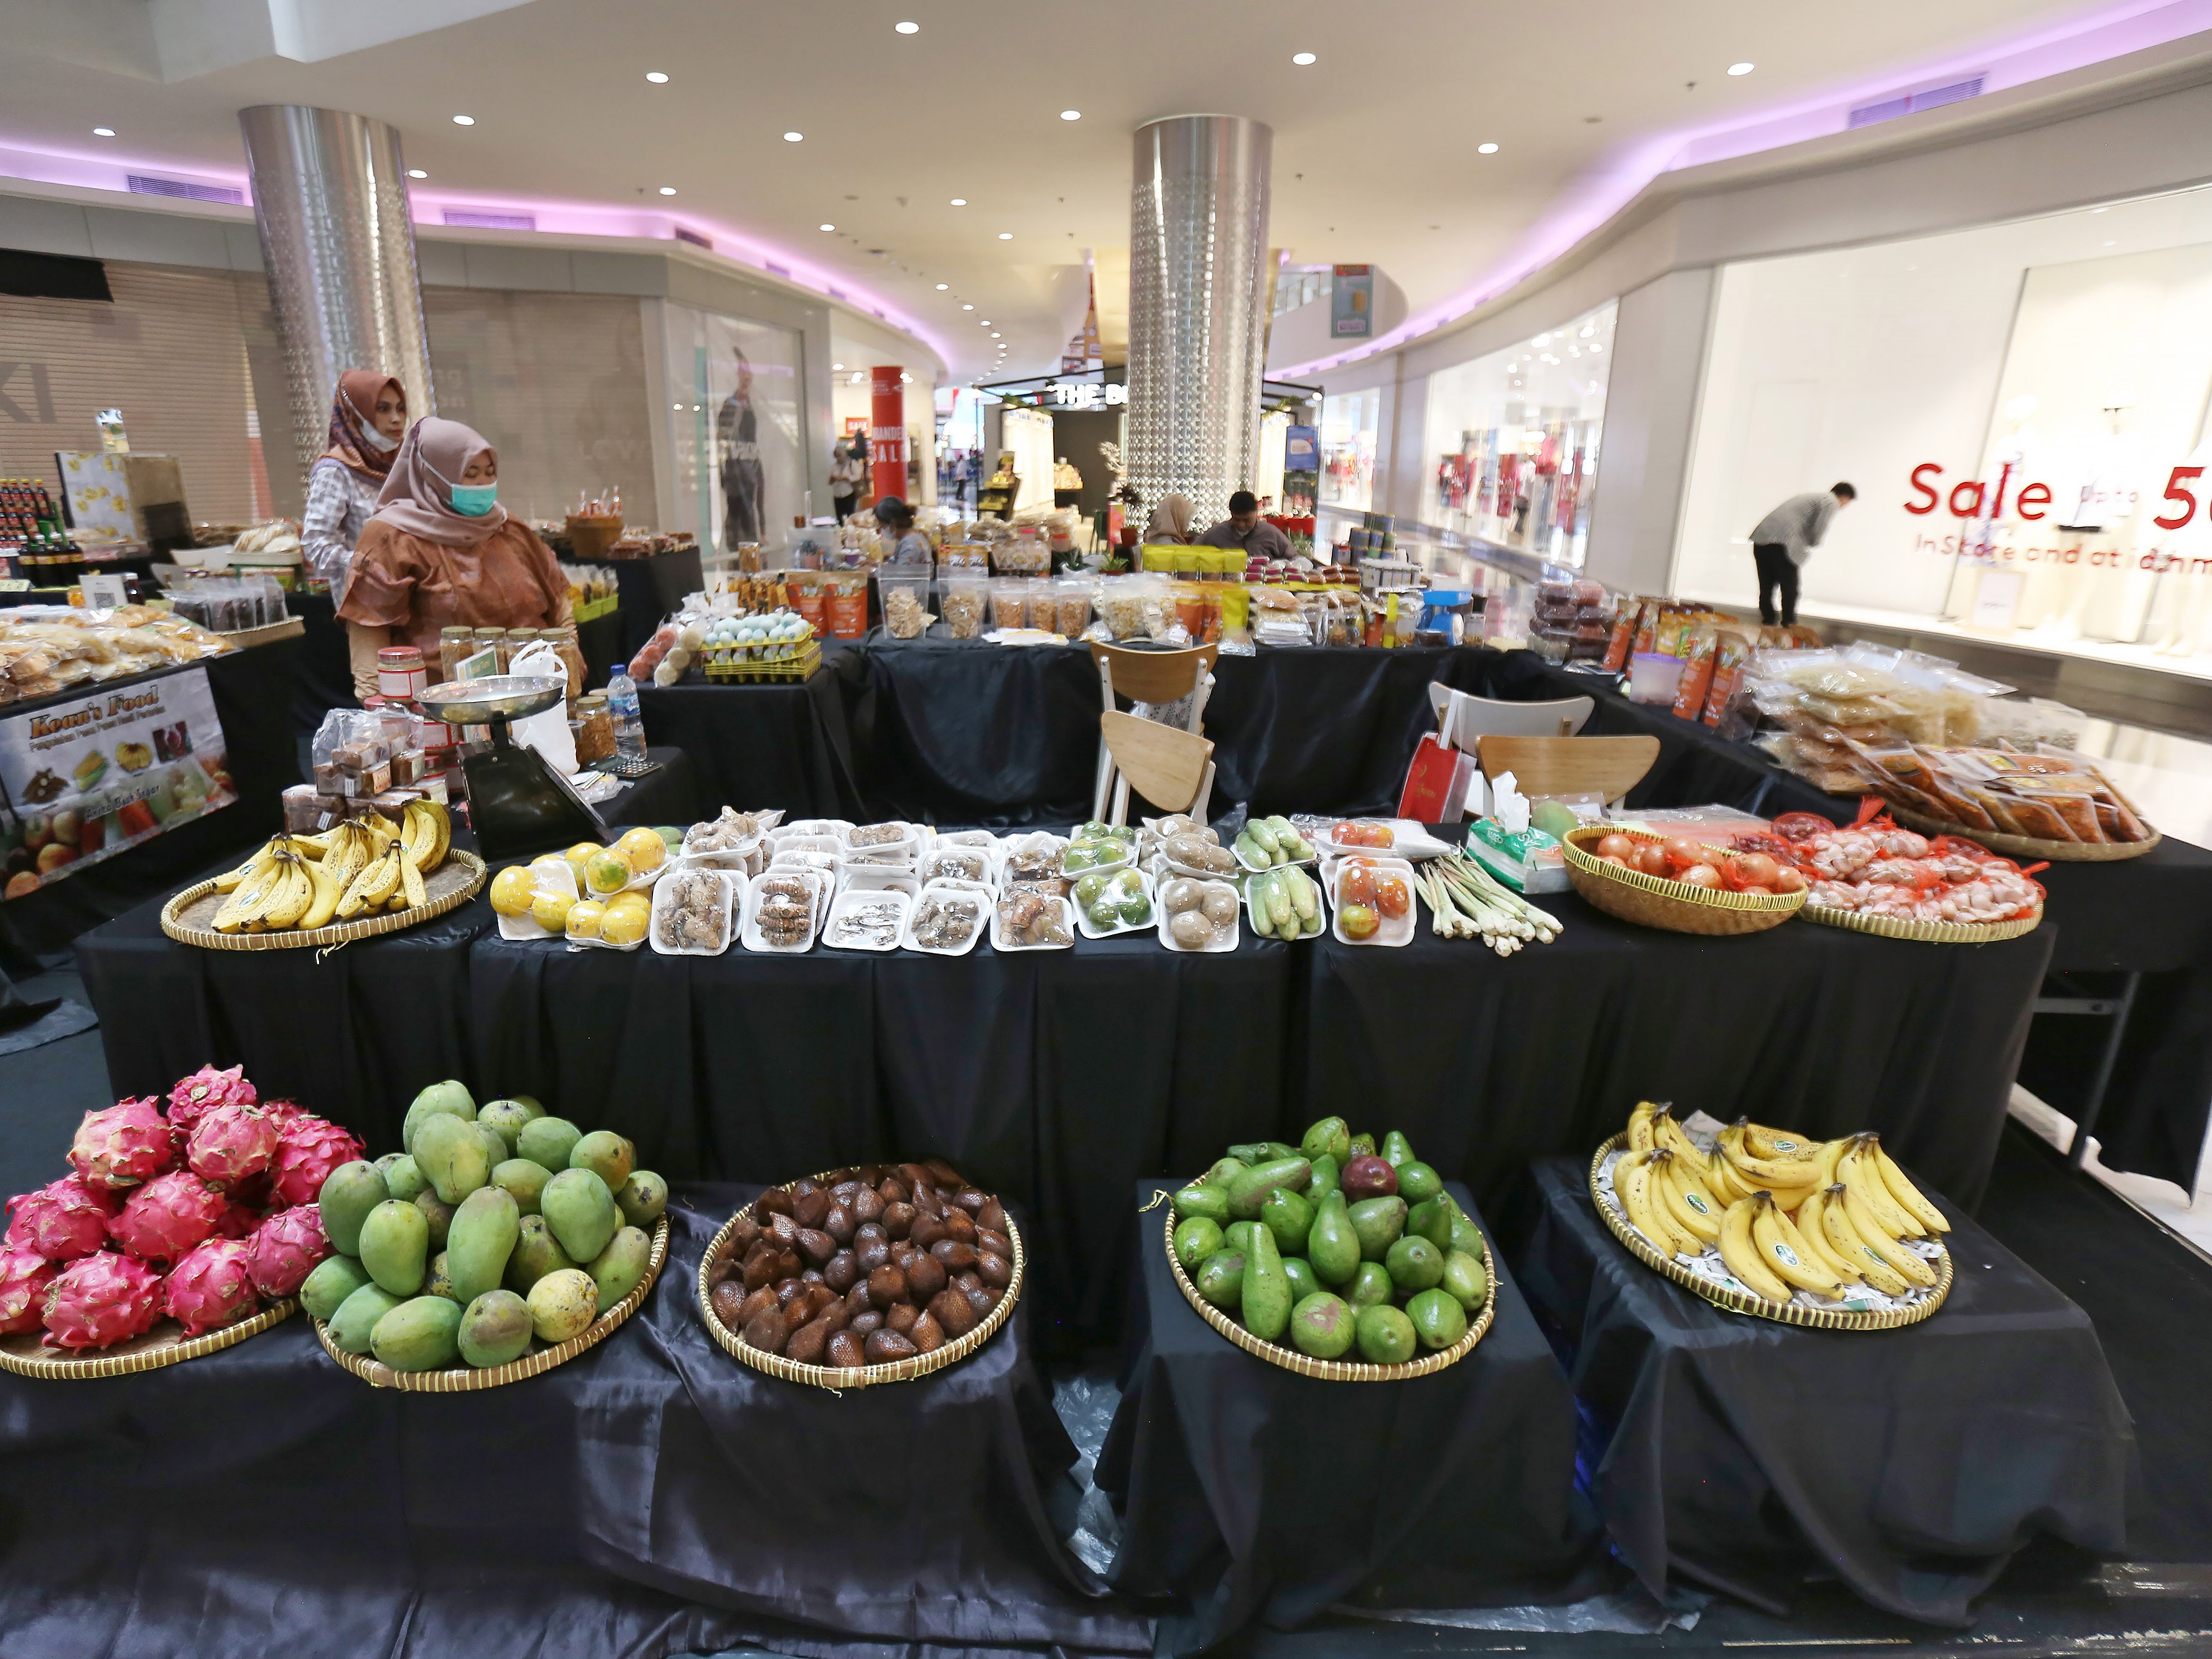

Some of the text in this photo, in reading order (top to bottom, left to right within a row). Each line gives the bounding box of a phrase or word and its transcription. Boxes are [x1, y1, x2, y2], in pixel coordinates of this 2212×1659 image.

[1053, 383, 1100, 406] THE
[1904, 462, 2051, 521] Sale
[2026, 544, 2083, 564] and
[2091, 548, 2123, 567] at
[108, 684, 159, 717] Food
